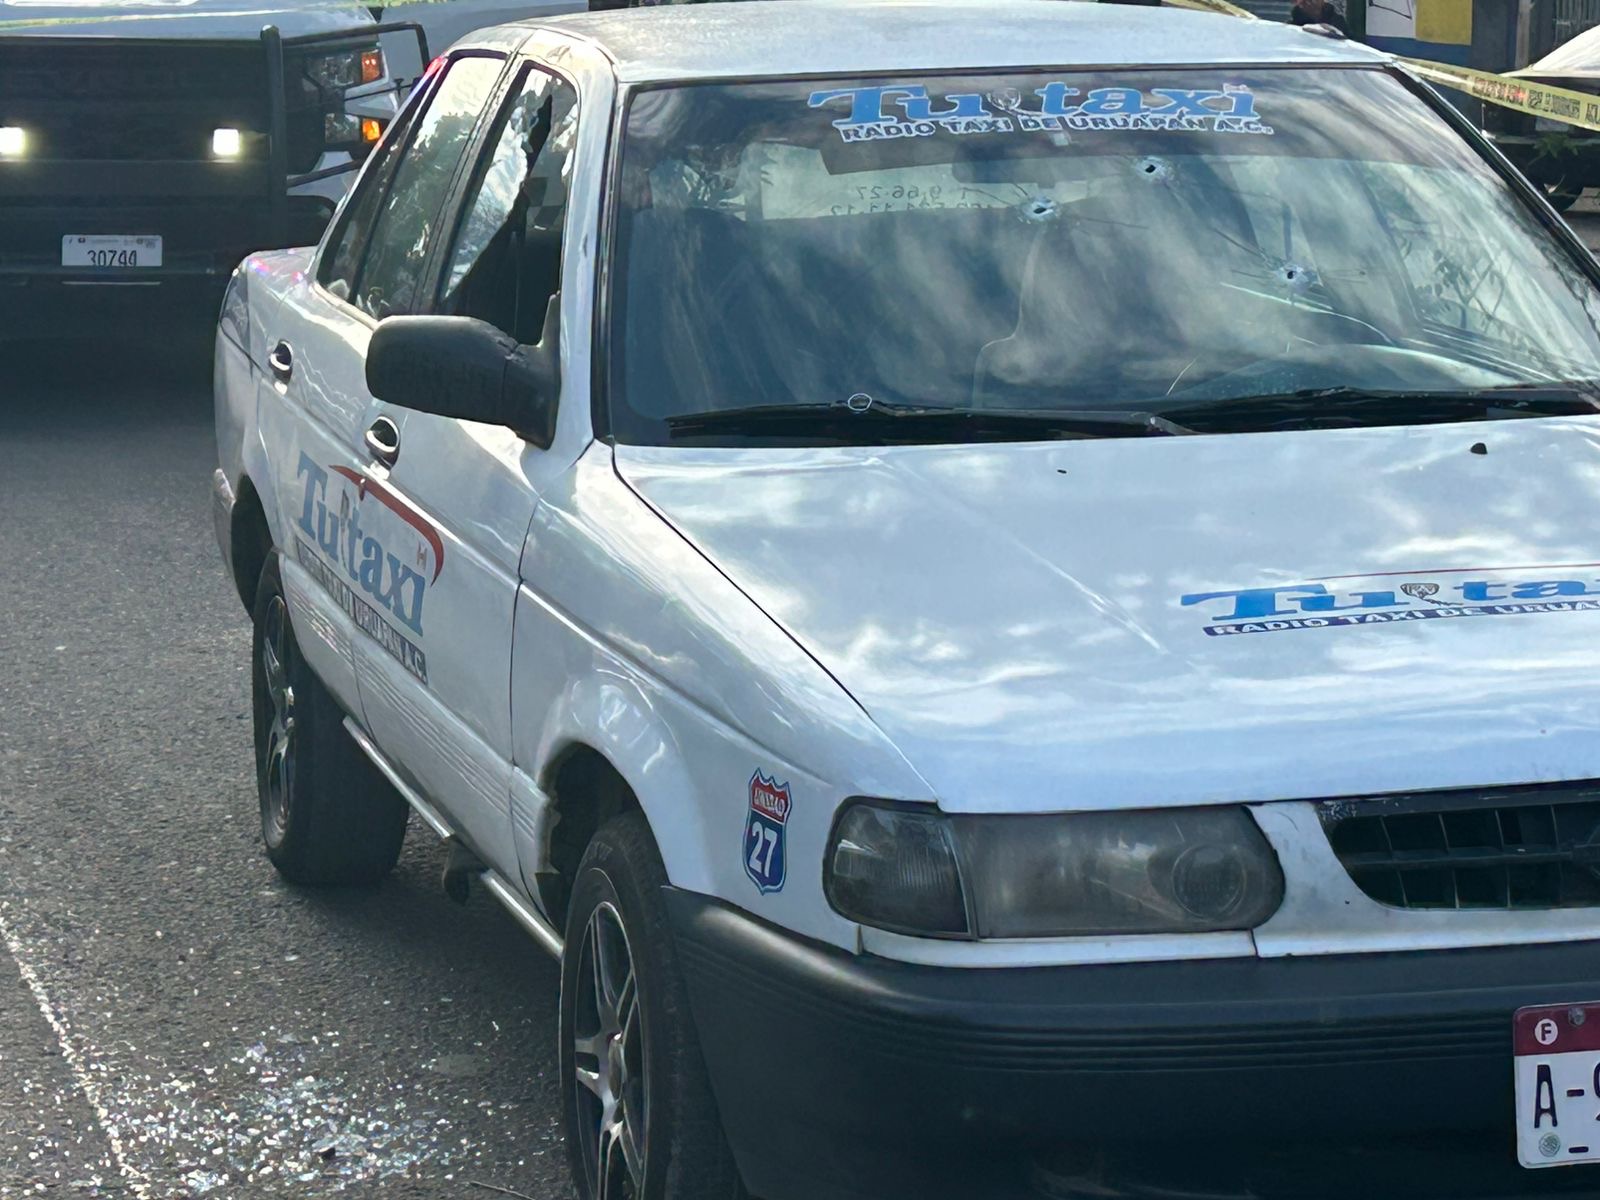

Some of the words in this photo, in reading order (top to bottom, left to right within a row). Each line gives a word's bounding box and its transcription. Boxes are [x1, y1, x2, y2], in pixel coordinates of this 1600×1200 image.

[807, 84, 992, 126] Tu
[1034, 81, 1261, 120] taxi
[840, 121, 936, 142] RADIO
[942, 118, 1014, 134] TAXI
[1018, 115, 1063, 131] DE
[1068, 114, 1205, 132] URUAPAN
[296, 450, 339, 561] Tu
[346, 505, 426, 637] taxi
[1180, 583, 1411, 622] Tu
[1452, 579, 1600, 601] ta
[1212, 617, 1329, 635] RADIO
[1337, 609, 1426, 625] TAXI
[1436, 606, 1489, 617] DE
[749, 821, 778, 878] 27
[1540, 1022, 1552, 1042] F
[1534, 1064, 1600, 1129] A-
